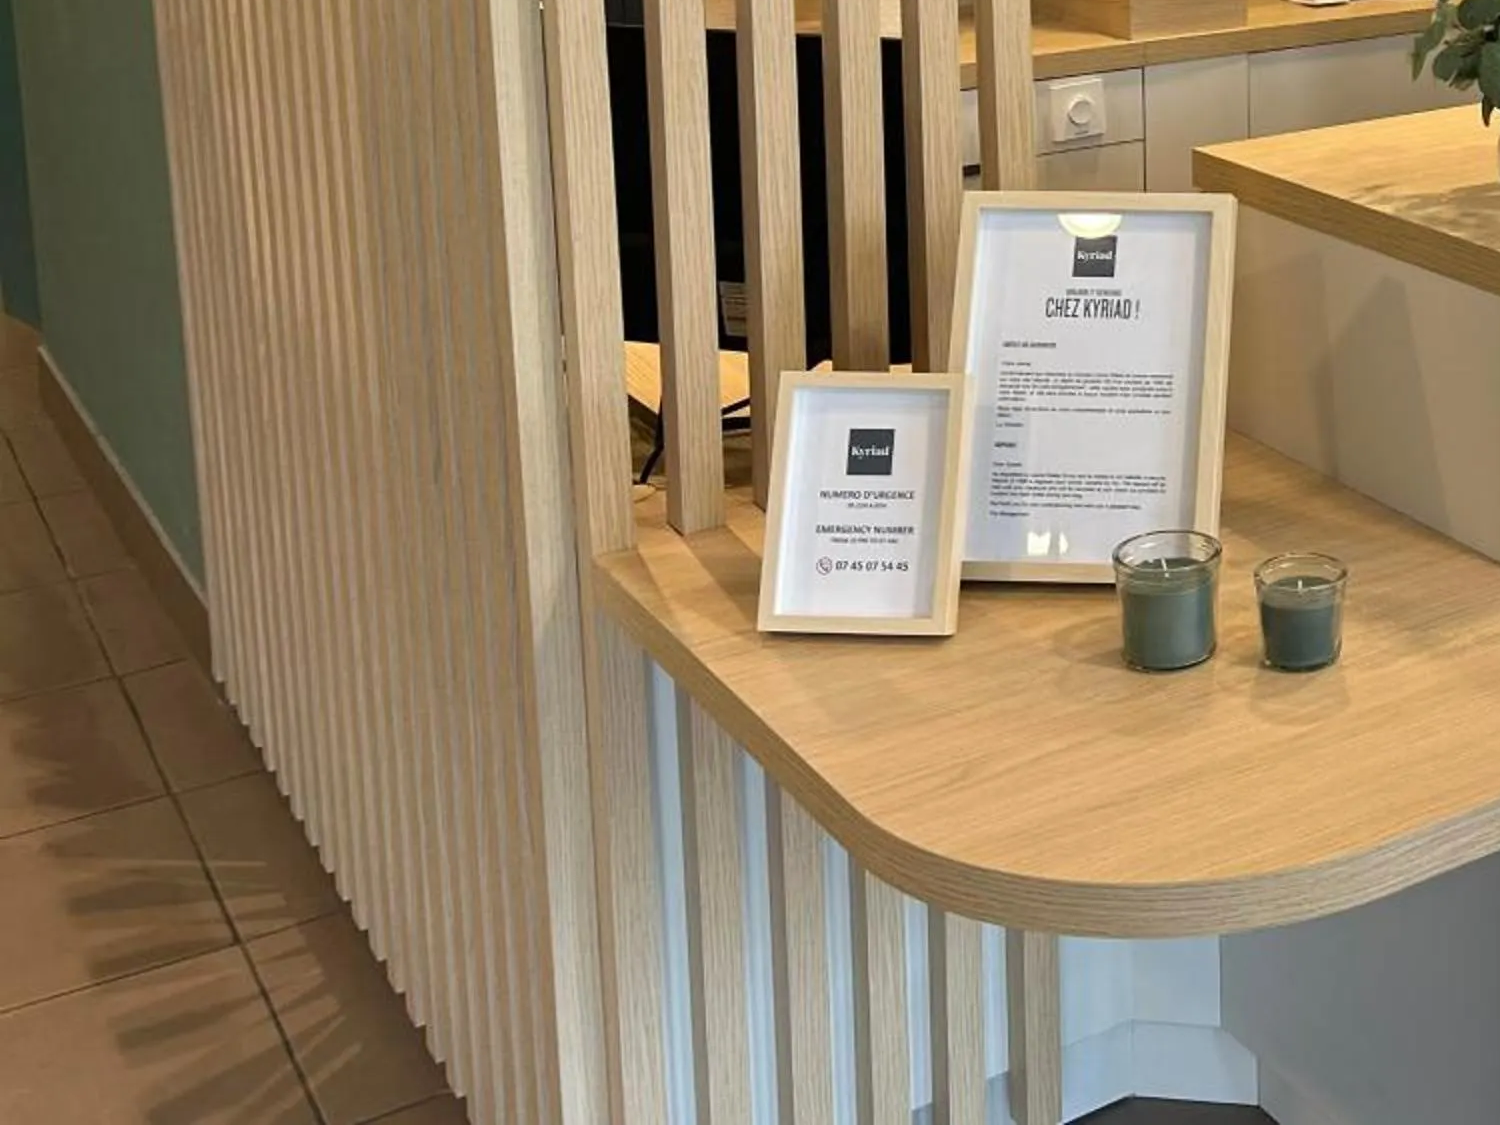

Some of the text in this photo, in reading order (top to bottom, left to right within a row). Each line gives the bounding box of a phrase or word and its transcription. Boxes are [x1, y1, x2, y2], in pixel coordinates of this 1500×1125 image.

[1077, 250, 1113, 263] Kyriad
[1045, 297, 1140, 320] CHEZ KYRIAD !
[835, 560, 909, 572] 07 45 07 54 45
